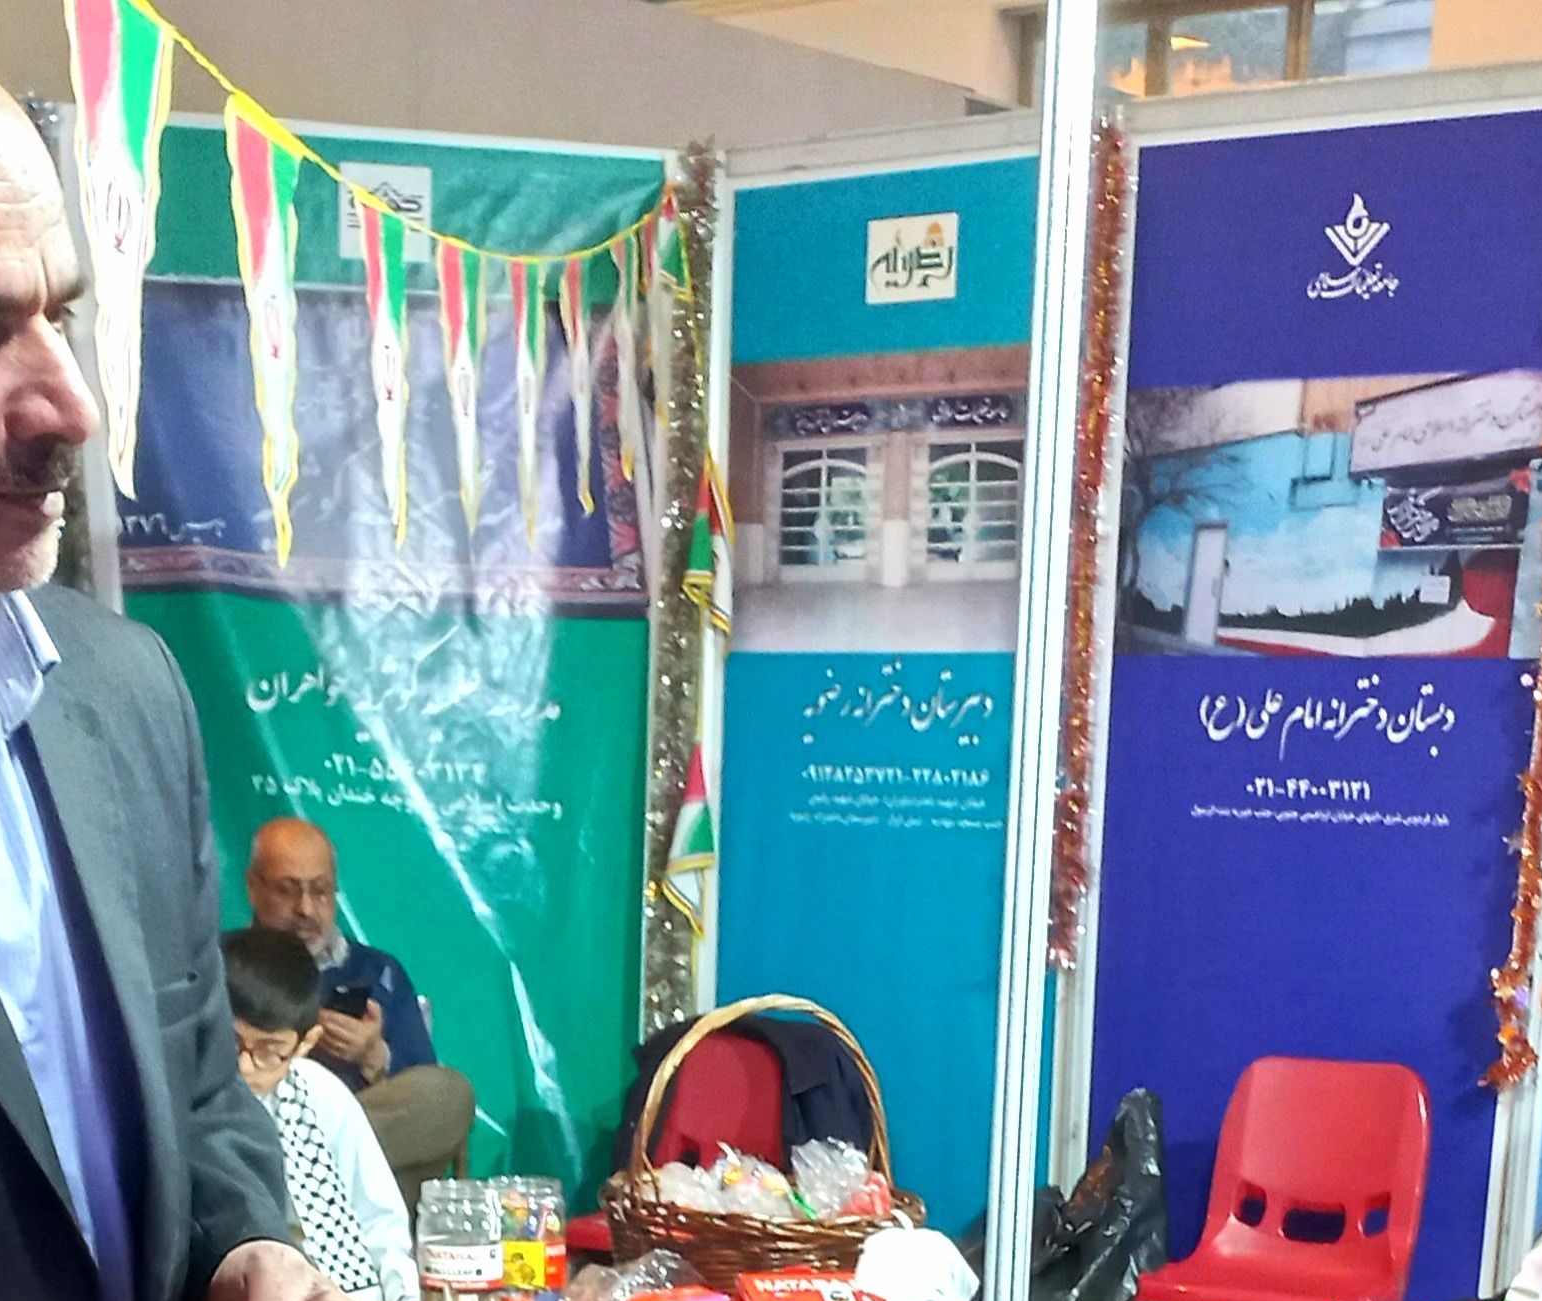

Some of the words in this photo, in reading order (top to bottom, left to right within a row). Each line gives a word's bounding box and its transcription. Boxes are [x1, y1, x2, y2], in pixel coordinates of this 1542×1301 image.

[1278, 697, 1323, 761] امام
[1323, 672, 1388, 741] دخترانه
[1386, 682, 1456, 757] دبستان
